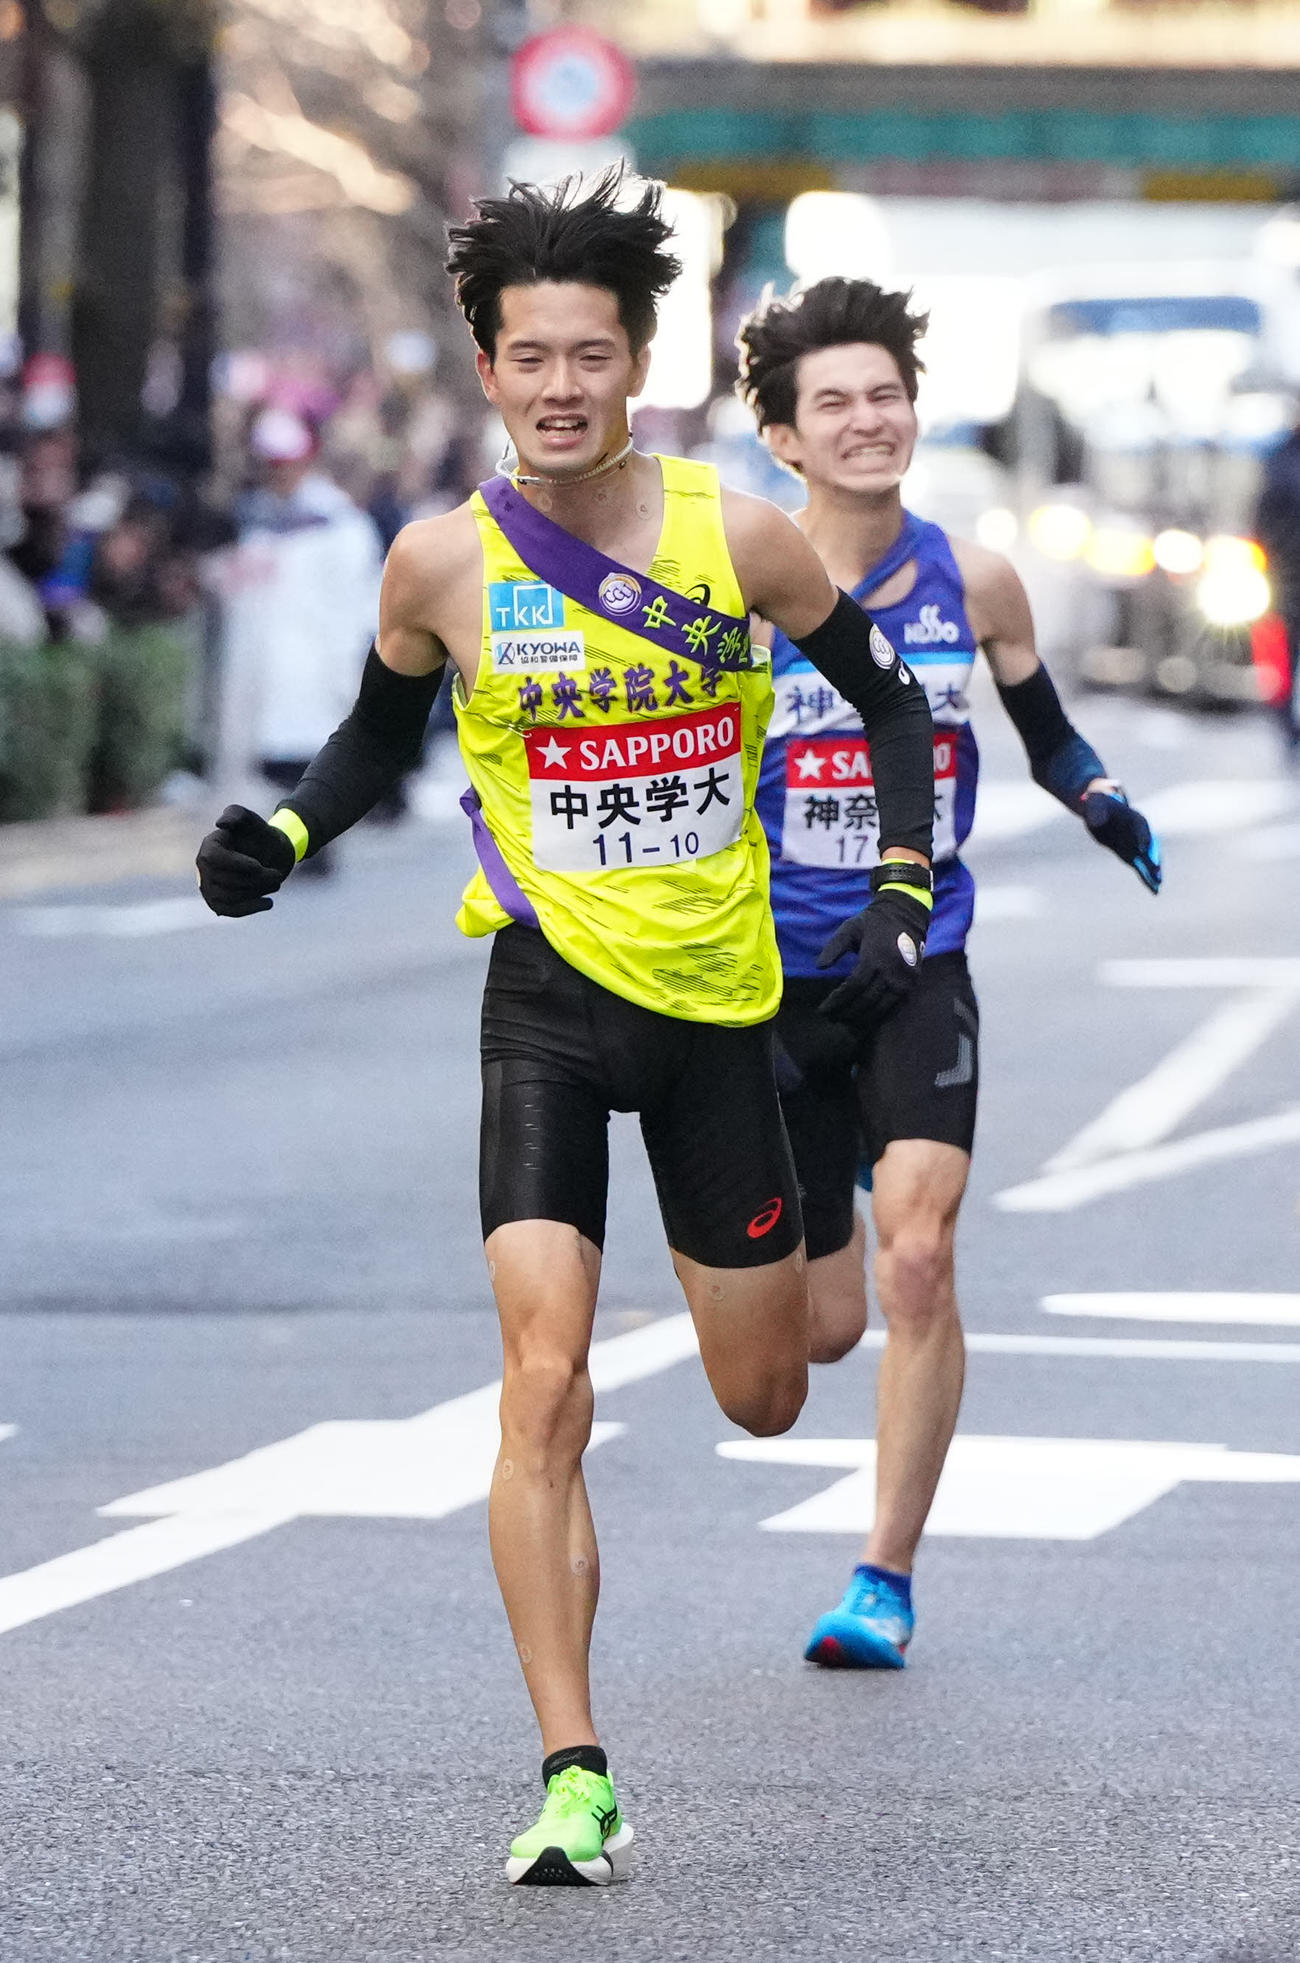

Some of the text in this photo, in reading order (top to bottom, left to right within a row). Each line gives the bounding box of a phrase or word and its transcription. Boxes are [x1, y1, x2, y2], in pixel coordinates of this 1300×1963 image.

[495, 584, 554, 627] TKK
[517, 641, 581, 655] KYOWA
[579, 716, 735, 771] SAPPORO
[550, 767, 731, 830] 中央学大
[593, 831, 700, 866] 11-10
